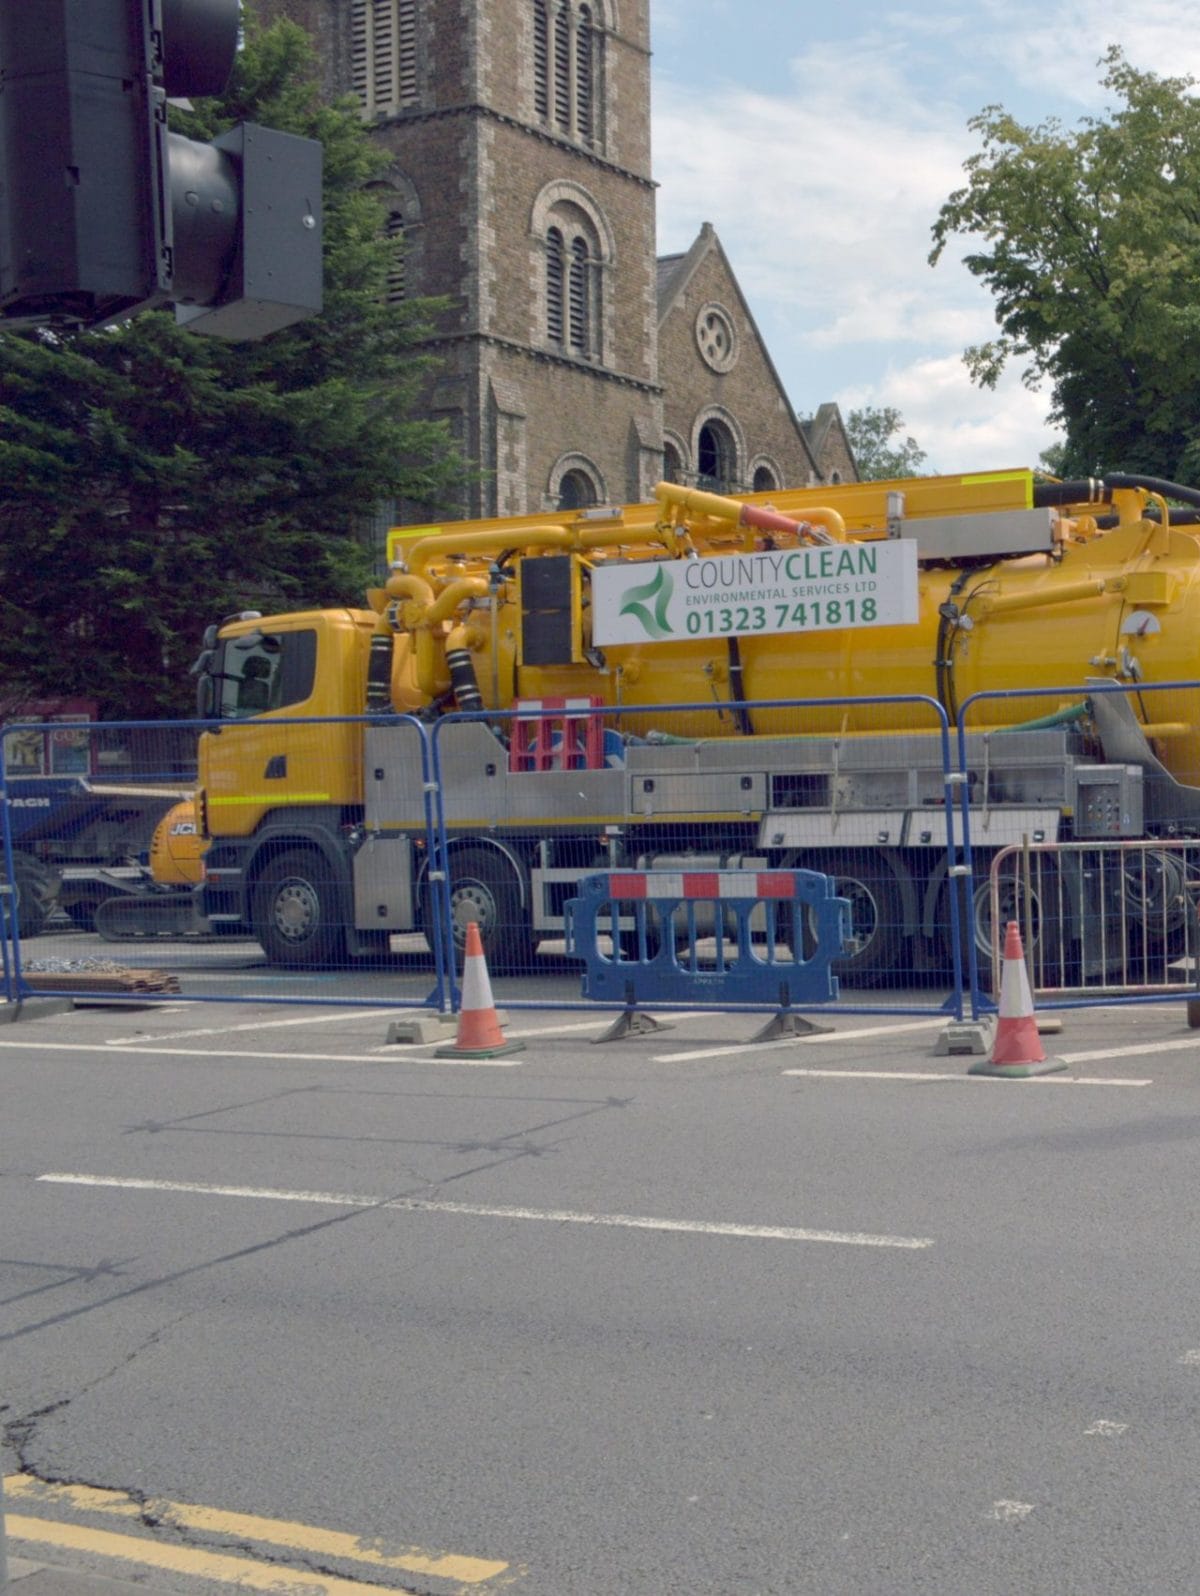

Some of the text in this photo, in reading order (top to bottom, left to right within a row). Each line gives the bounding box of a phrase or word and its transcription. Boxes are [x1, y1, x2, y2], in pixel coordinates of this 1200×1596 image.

[685, 547, 877, 588] COUNTYCLEAN
[686, 581, 876, 605] ENVIRONMENTAL SERVICES LTD
[686, 597, 877, 635] 01323 741818
